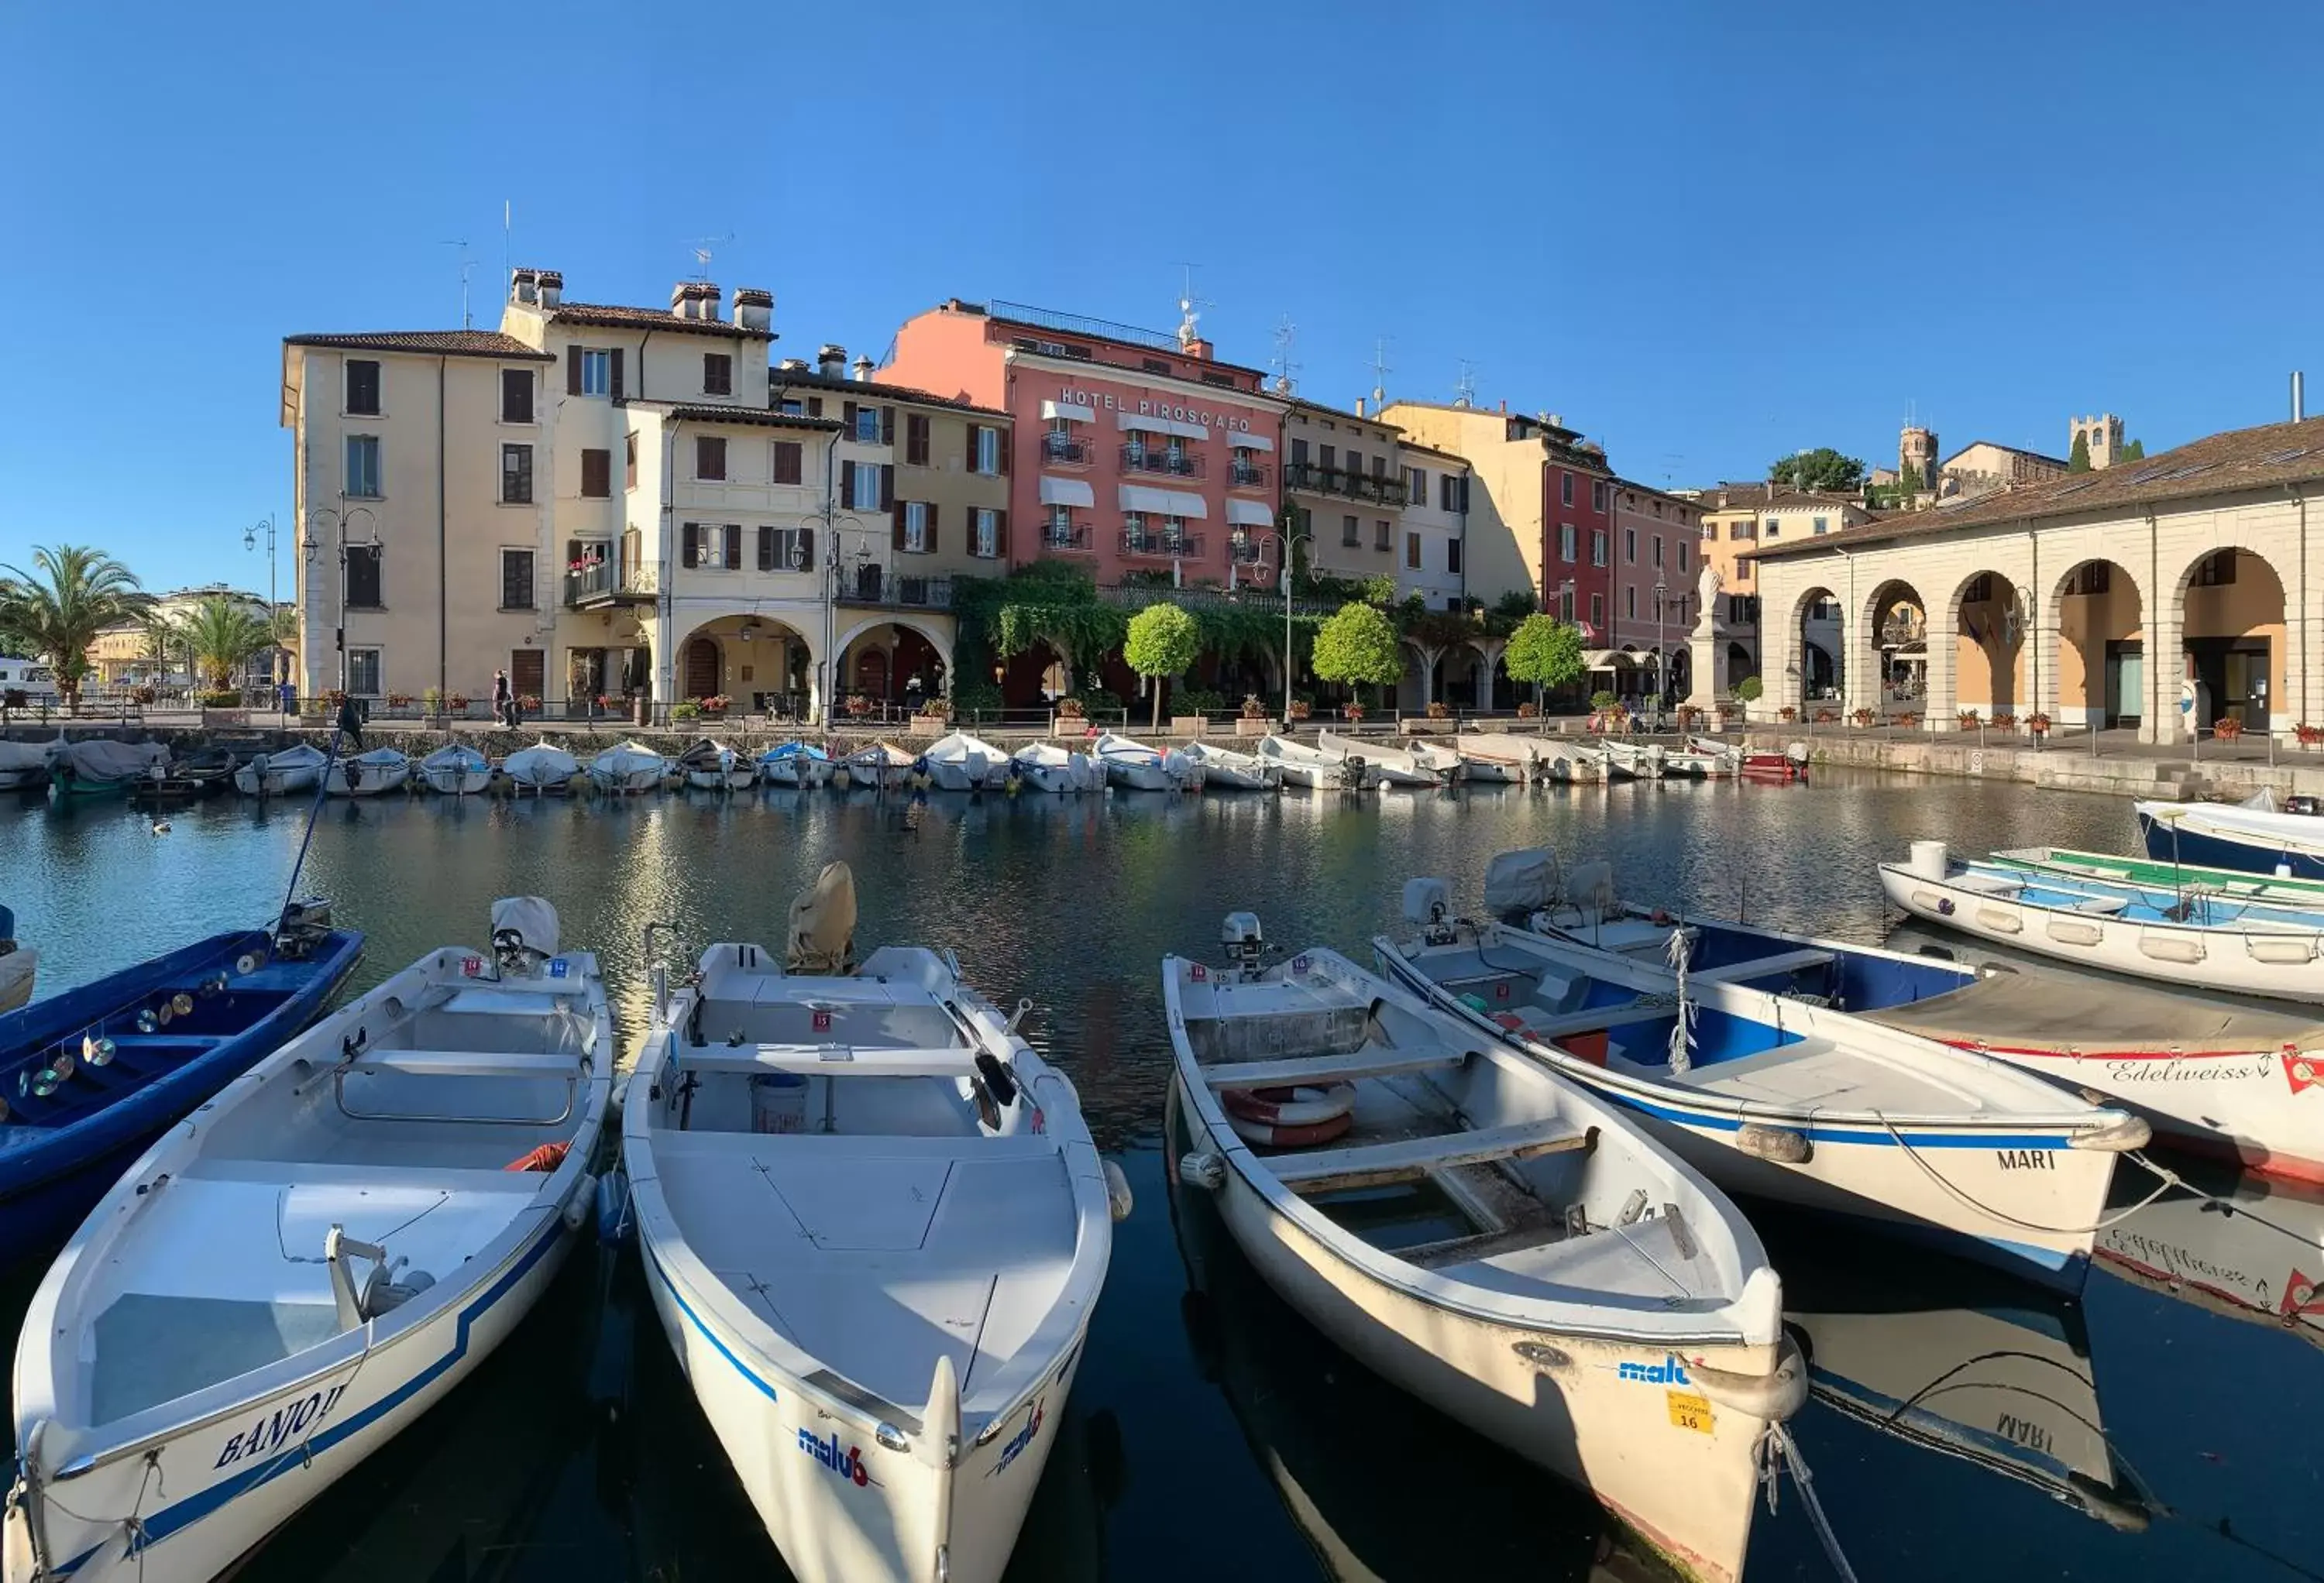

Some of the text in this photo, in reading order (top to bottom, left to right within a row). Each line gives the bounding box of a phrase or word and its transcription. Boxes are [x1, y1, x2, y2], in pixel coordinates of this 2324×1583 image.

[1061, 388, 1250, 431] HOTEL PIROSCAFO
[2106, 1059, 2252, 1083] Edelweiss
[1996, 1150, 2055, 1170] MARI
[213, 1392, 321, 1470] BANJO
[1680, 1415, 1698, 1429] 16
[798, 1427, 868, 1487] malu6
